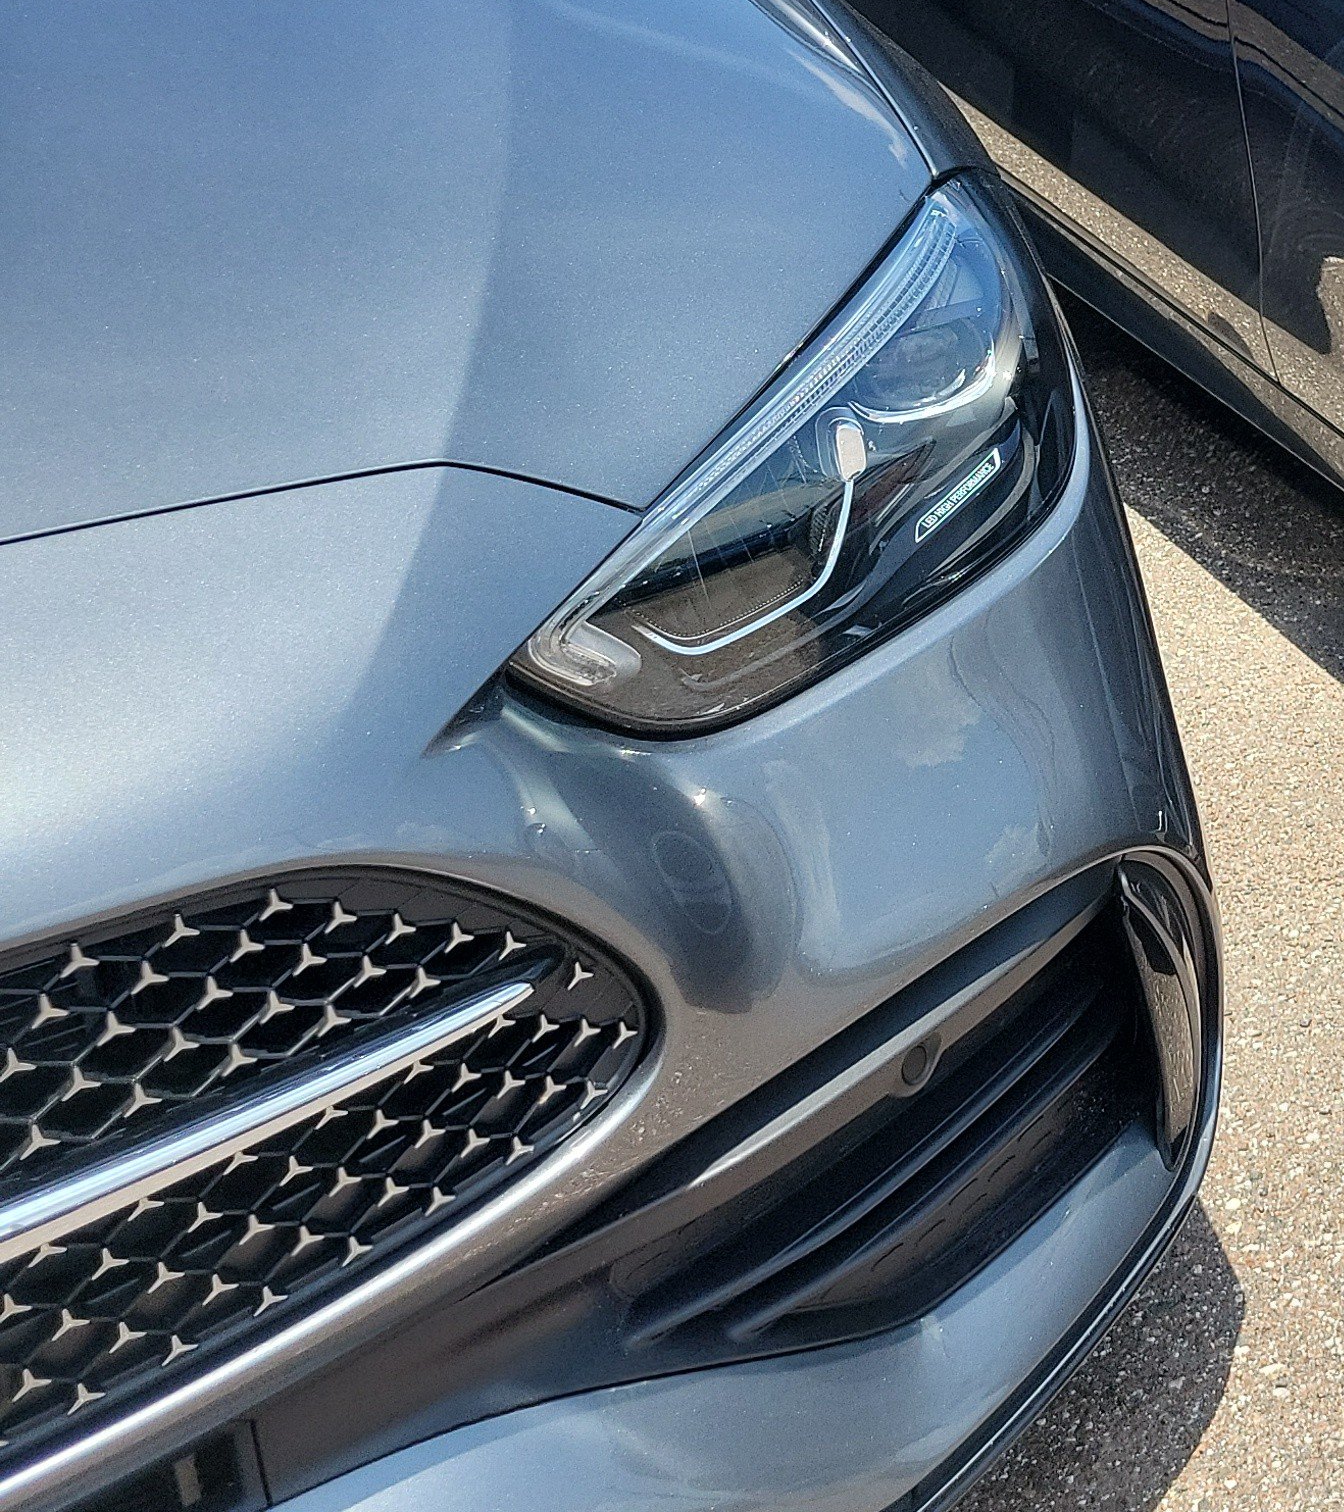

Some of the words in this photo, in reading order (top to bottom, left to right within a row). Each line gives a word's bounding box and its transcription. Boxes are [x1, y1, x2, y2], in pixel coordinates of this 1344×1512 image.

[921, 514, 939, 528] LED
[935, 501, 954, 517] HIGH
[952, 462, 994, 504] PERFORMANCE
